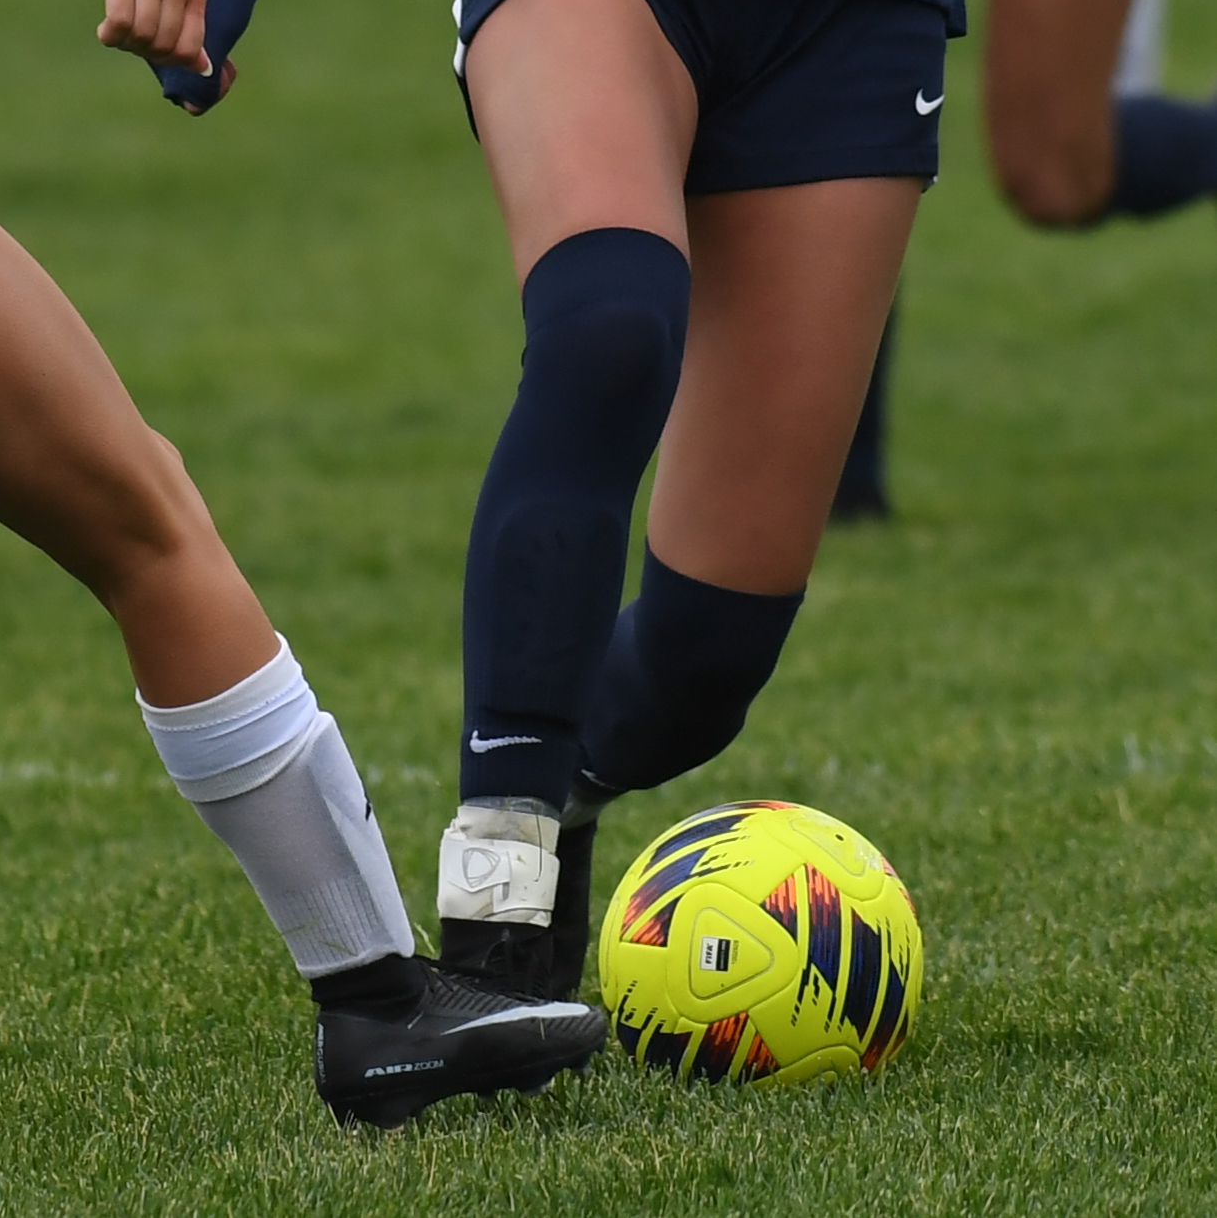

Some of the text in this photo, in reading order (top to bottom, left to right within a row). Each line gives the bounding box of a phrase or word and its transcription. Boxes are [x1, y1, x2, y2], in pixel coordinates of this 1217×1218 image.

[705, 944, 714, 964] FIFA
[364, 1059, 444, 1078] AIR ZOOM
